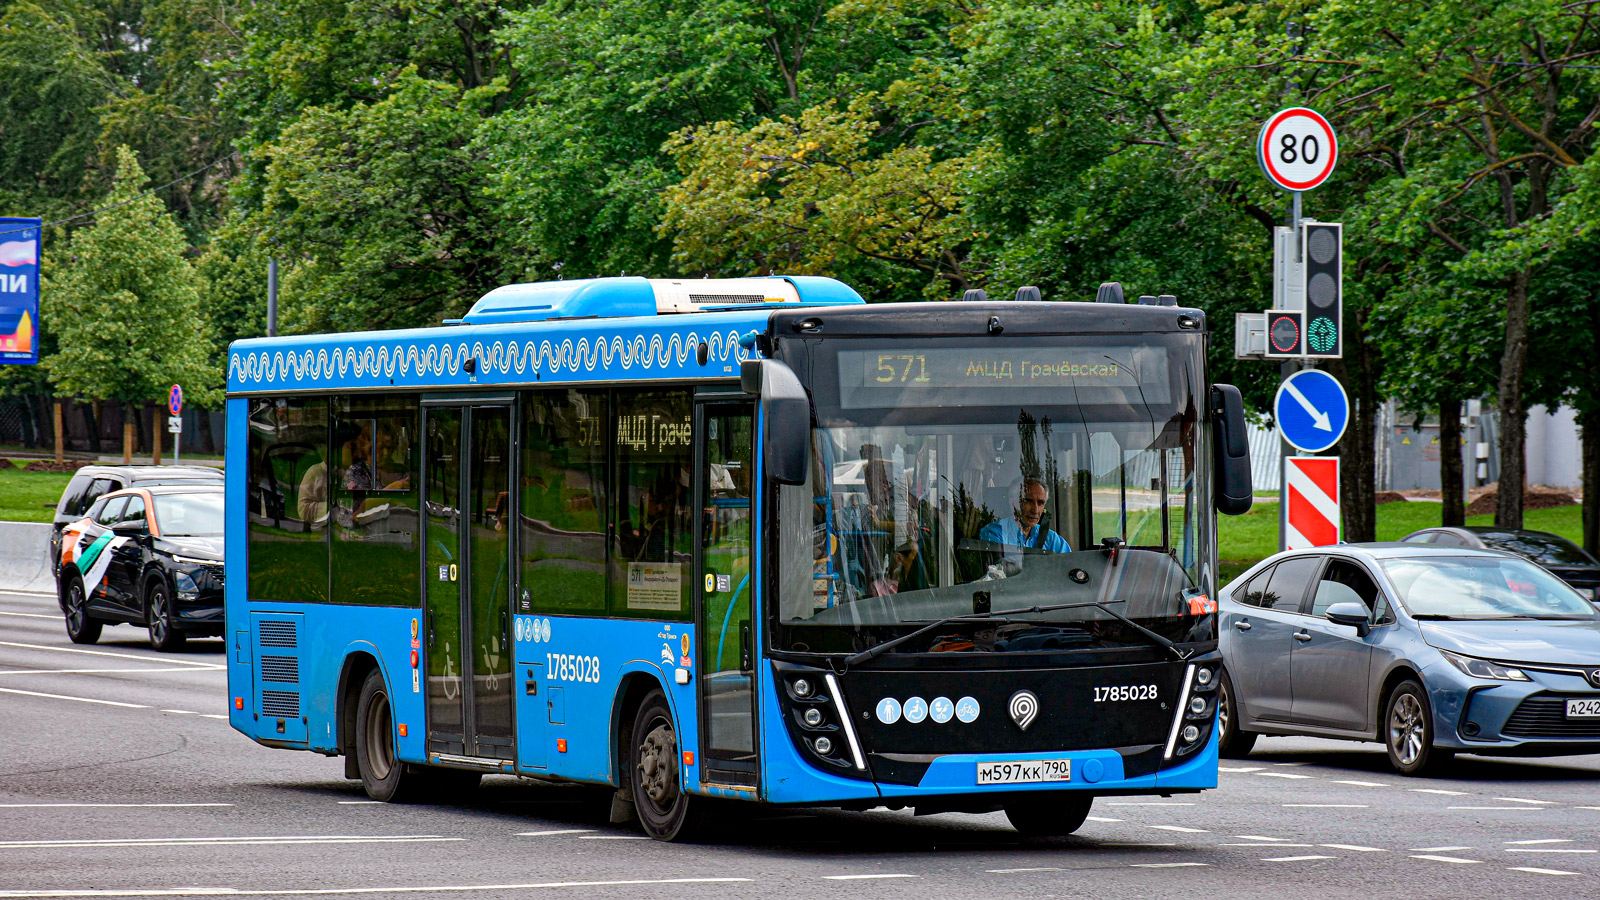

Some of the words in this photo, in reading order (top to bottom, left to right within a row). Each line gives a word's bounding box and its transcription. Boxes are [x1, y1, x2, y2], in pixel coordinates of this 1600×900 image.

[1280, 133, 1319, 165] 80
[876, 354, 931, 383] 571
[966, 360, 1013, 379] МЦД
[1020, 360, 1118, 378] Грачёвская
[577, 416, 600, 446] 571
[617, 415, 646, 451] МЦД
[652, 415, 691, 452] Грачё
[631, 569, 641, 582] 571
[547, 653, 600, 683] 1785028
[1093, 685, 1158, 702] 1785028
[1570, 702, 1600, 714] А242
[1044, 761, 1067, 774] 790
